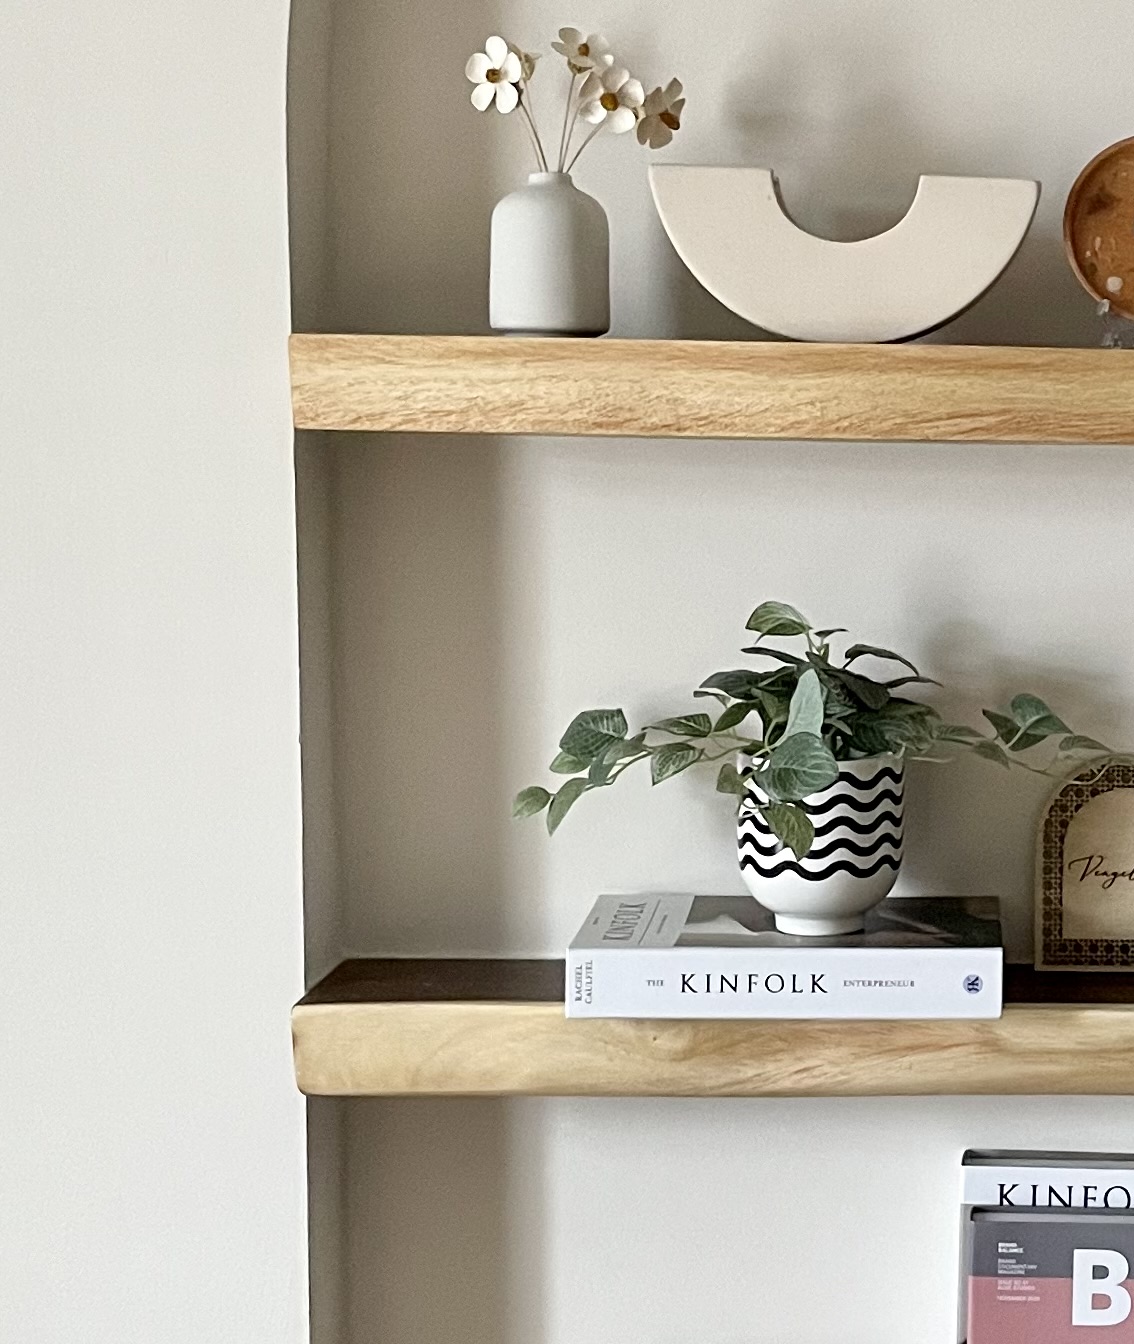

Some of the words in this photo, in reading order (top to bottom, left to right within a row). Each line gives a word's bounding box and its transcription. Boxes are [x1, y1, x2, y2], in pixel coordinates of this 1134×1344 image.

[602, 902, 647, 941] KINFOLK
[680, 973, 828, 994] KINFOLK
[1072, 1248, 1132, 1326] B
